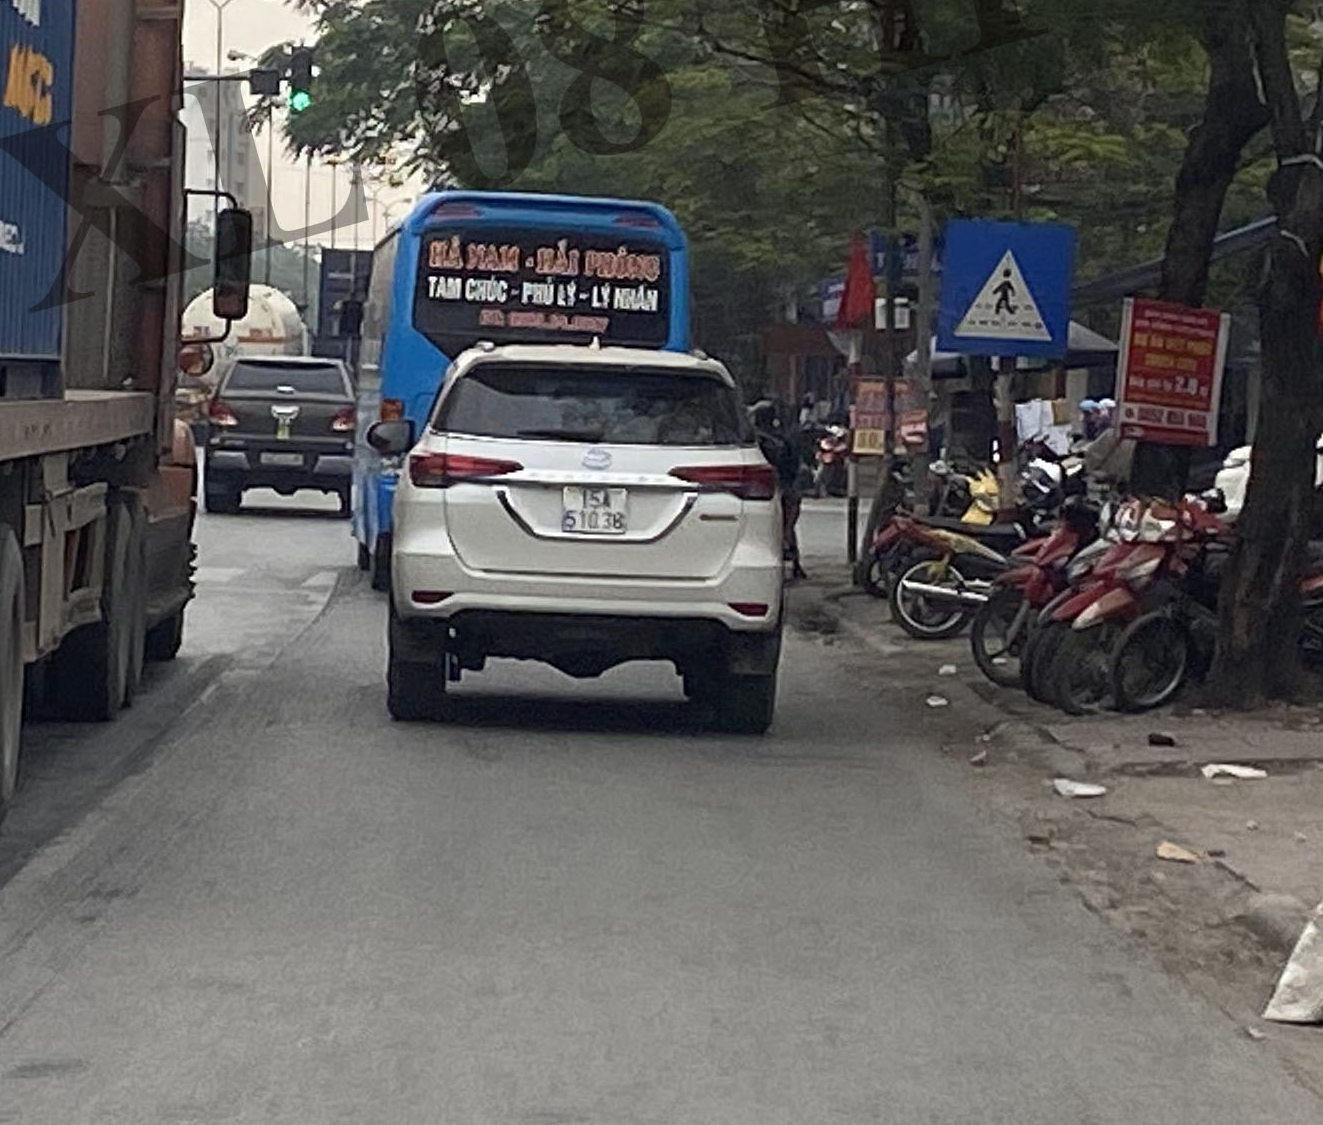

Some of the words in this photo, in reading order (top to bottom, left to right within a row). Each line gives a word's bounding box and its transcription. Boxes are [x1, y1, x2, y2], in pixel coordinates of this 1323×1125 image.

[465, 243, 520, 272] NAM
[428, 276, 462, 300] TAM
[465, 273, 509, 303] CHÚC
[583, 489, 612, 509] 15A
